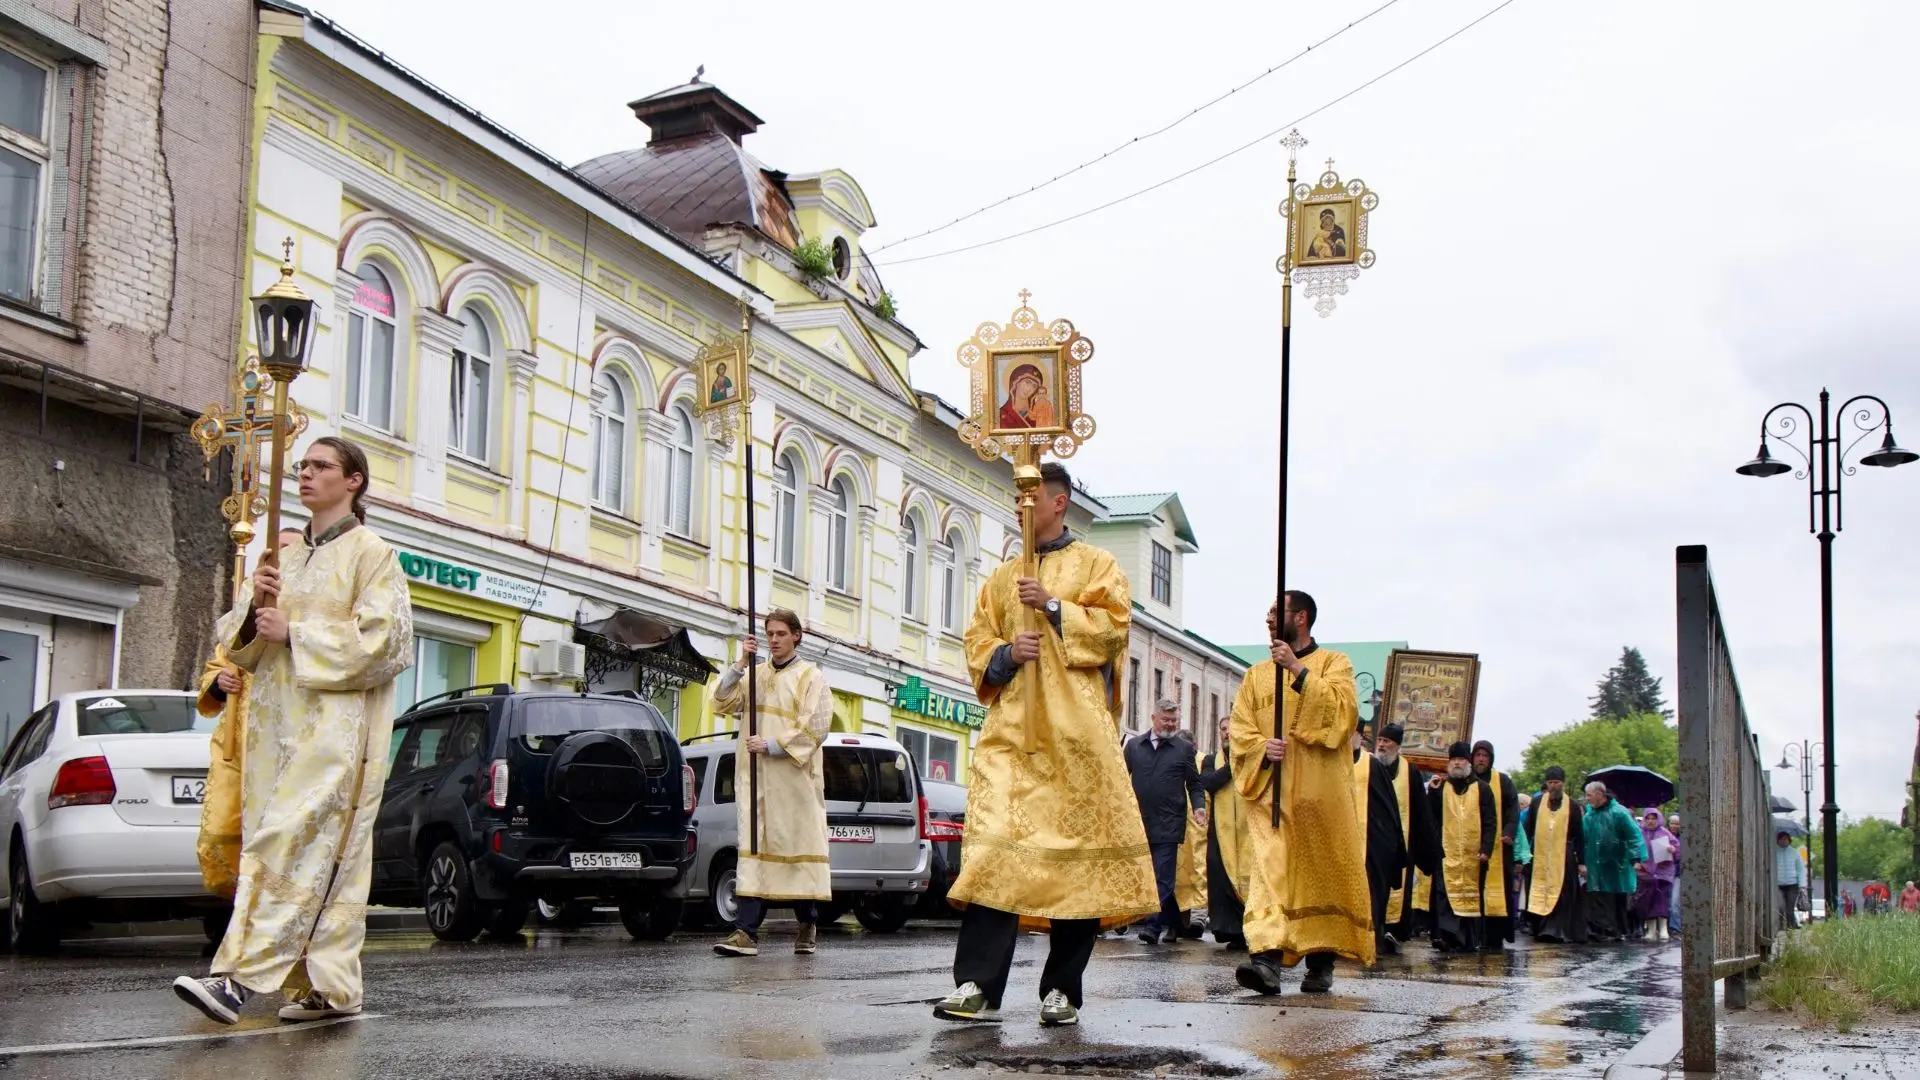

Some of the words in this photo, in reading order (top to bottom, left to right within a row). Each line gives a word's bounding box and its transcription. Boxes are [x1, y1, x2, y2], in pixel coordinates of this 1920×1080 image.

[486, 576, 547, 596] МЕДИЦИНСКАЯ
[967, 704, 988, 718] ПЛАНЕТ
[966, 714, 985, 727] ЗДОРО
